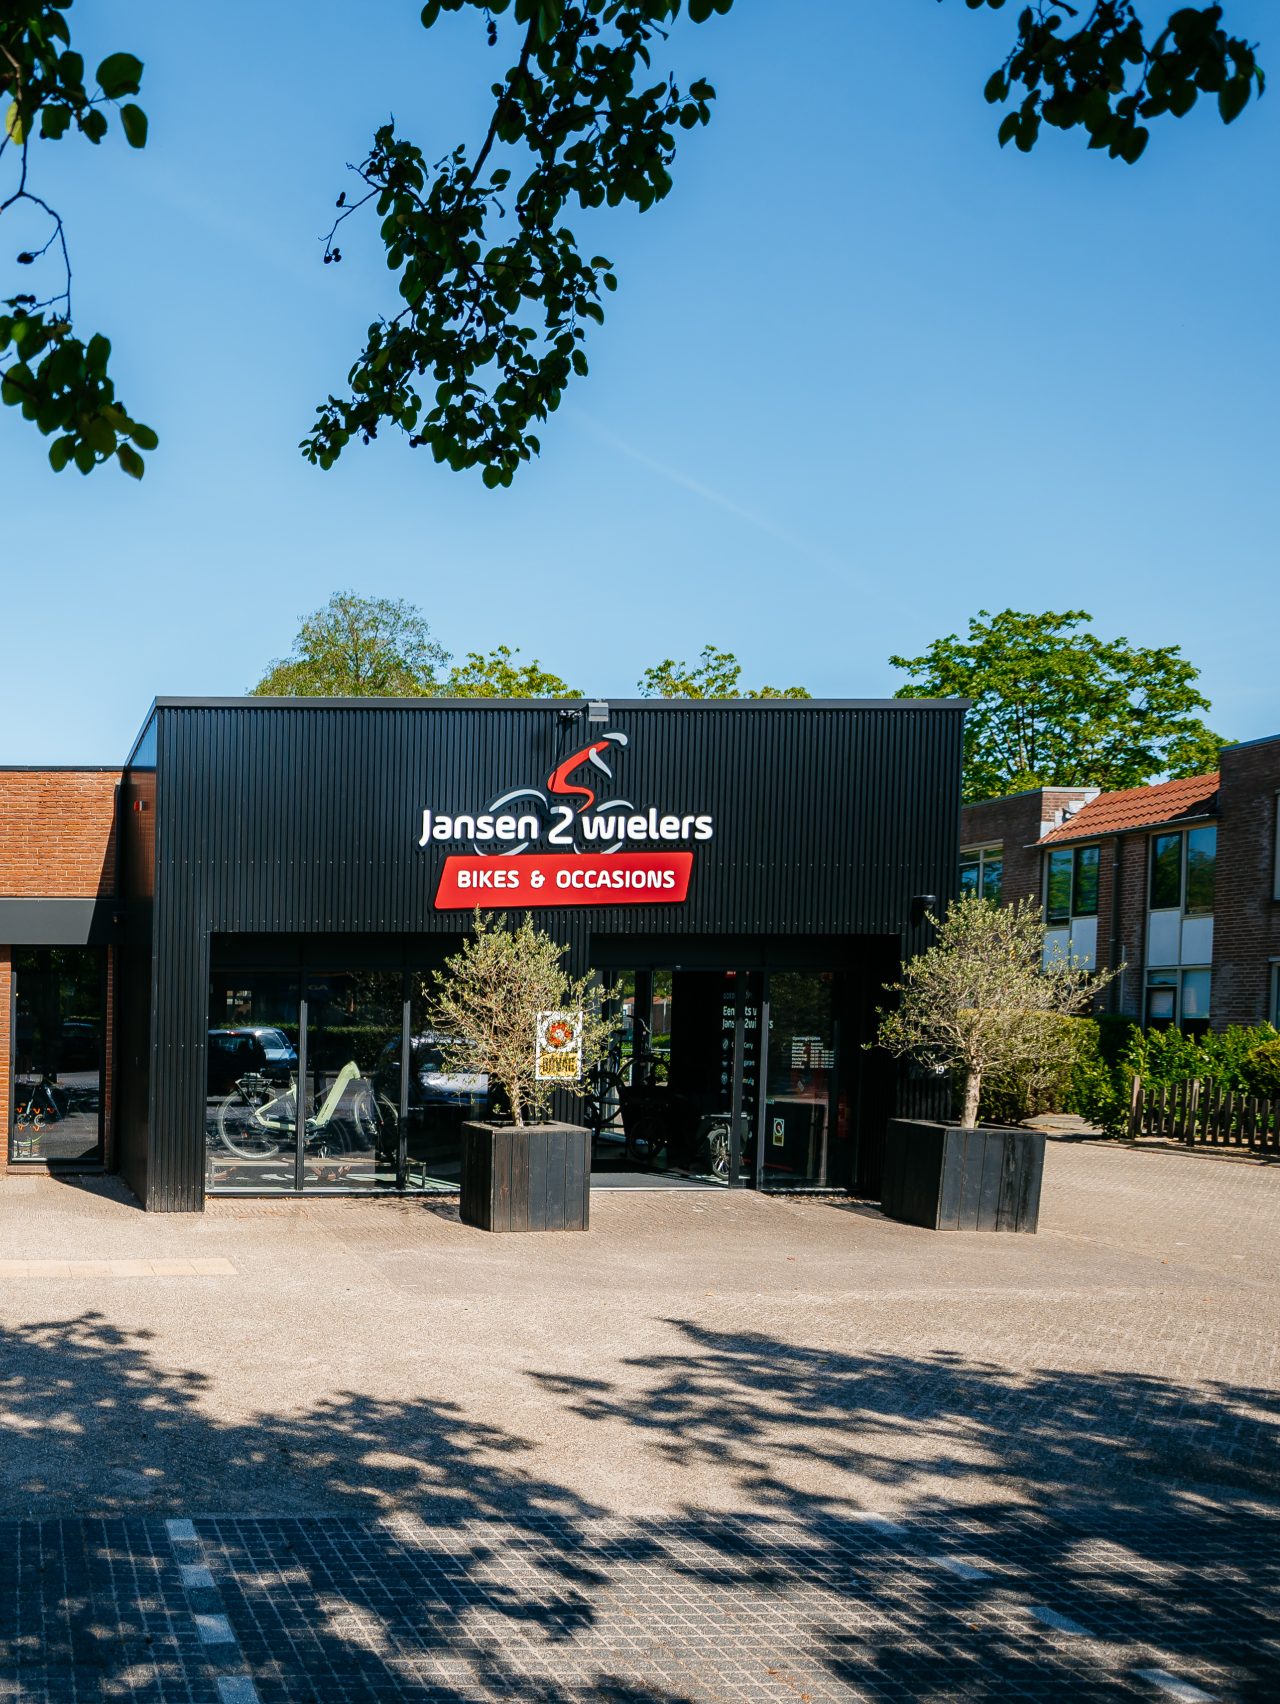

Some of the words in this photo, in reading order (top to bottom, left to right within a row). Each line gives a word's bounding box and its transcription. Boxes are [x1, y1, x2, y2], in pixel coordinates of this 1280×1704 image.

[419, 809, 538, 847] Jansen
[548, 806, 574, 844] 2
[582, 807, 713, 840] wielers
[457, 870, 519, 888] BIKES
[530, 870, 545, 888] &
[556, 870, 675, 888] OCCASIONS
